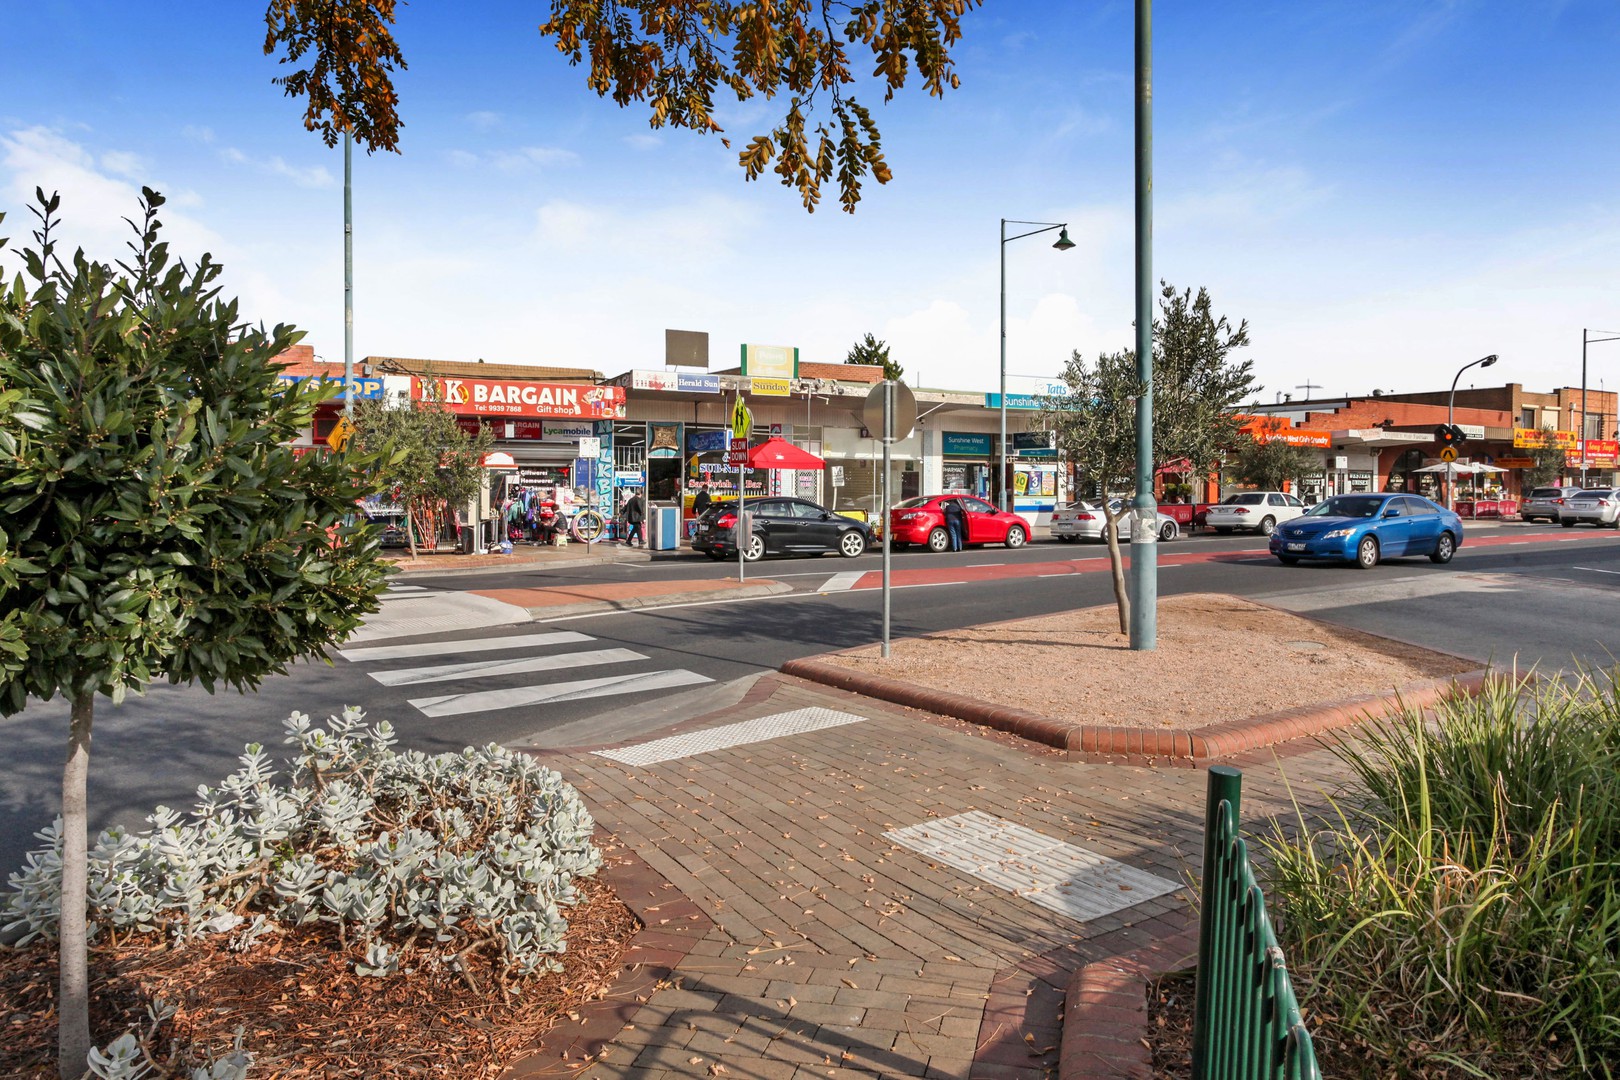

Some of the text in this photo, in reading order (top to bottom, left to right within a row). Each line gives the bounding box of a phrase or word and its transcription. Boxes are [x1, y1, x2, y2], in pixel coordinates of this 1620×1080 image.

[679, 378, 718, 389] Herald Sun
[753, 382, 788, 392] Sunday
[1046, 383, 1067, 394] Tatts
[474, 384, 577, 406] BARGAIN
[1004, 396, 1039, 407] Sunshine
[474, 404, 487, 412] Tel:
[536, 405, 574, 415] Gift shop
[544, 426, 591, 436] Lycamobile
[732, 440, 747, 450] SLOW
[732, 452, 747, 461] DOWN
[688, 479, 762, 489] Sandwich Bar
[1032, 476, 1038, 487] 3
